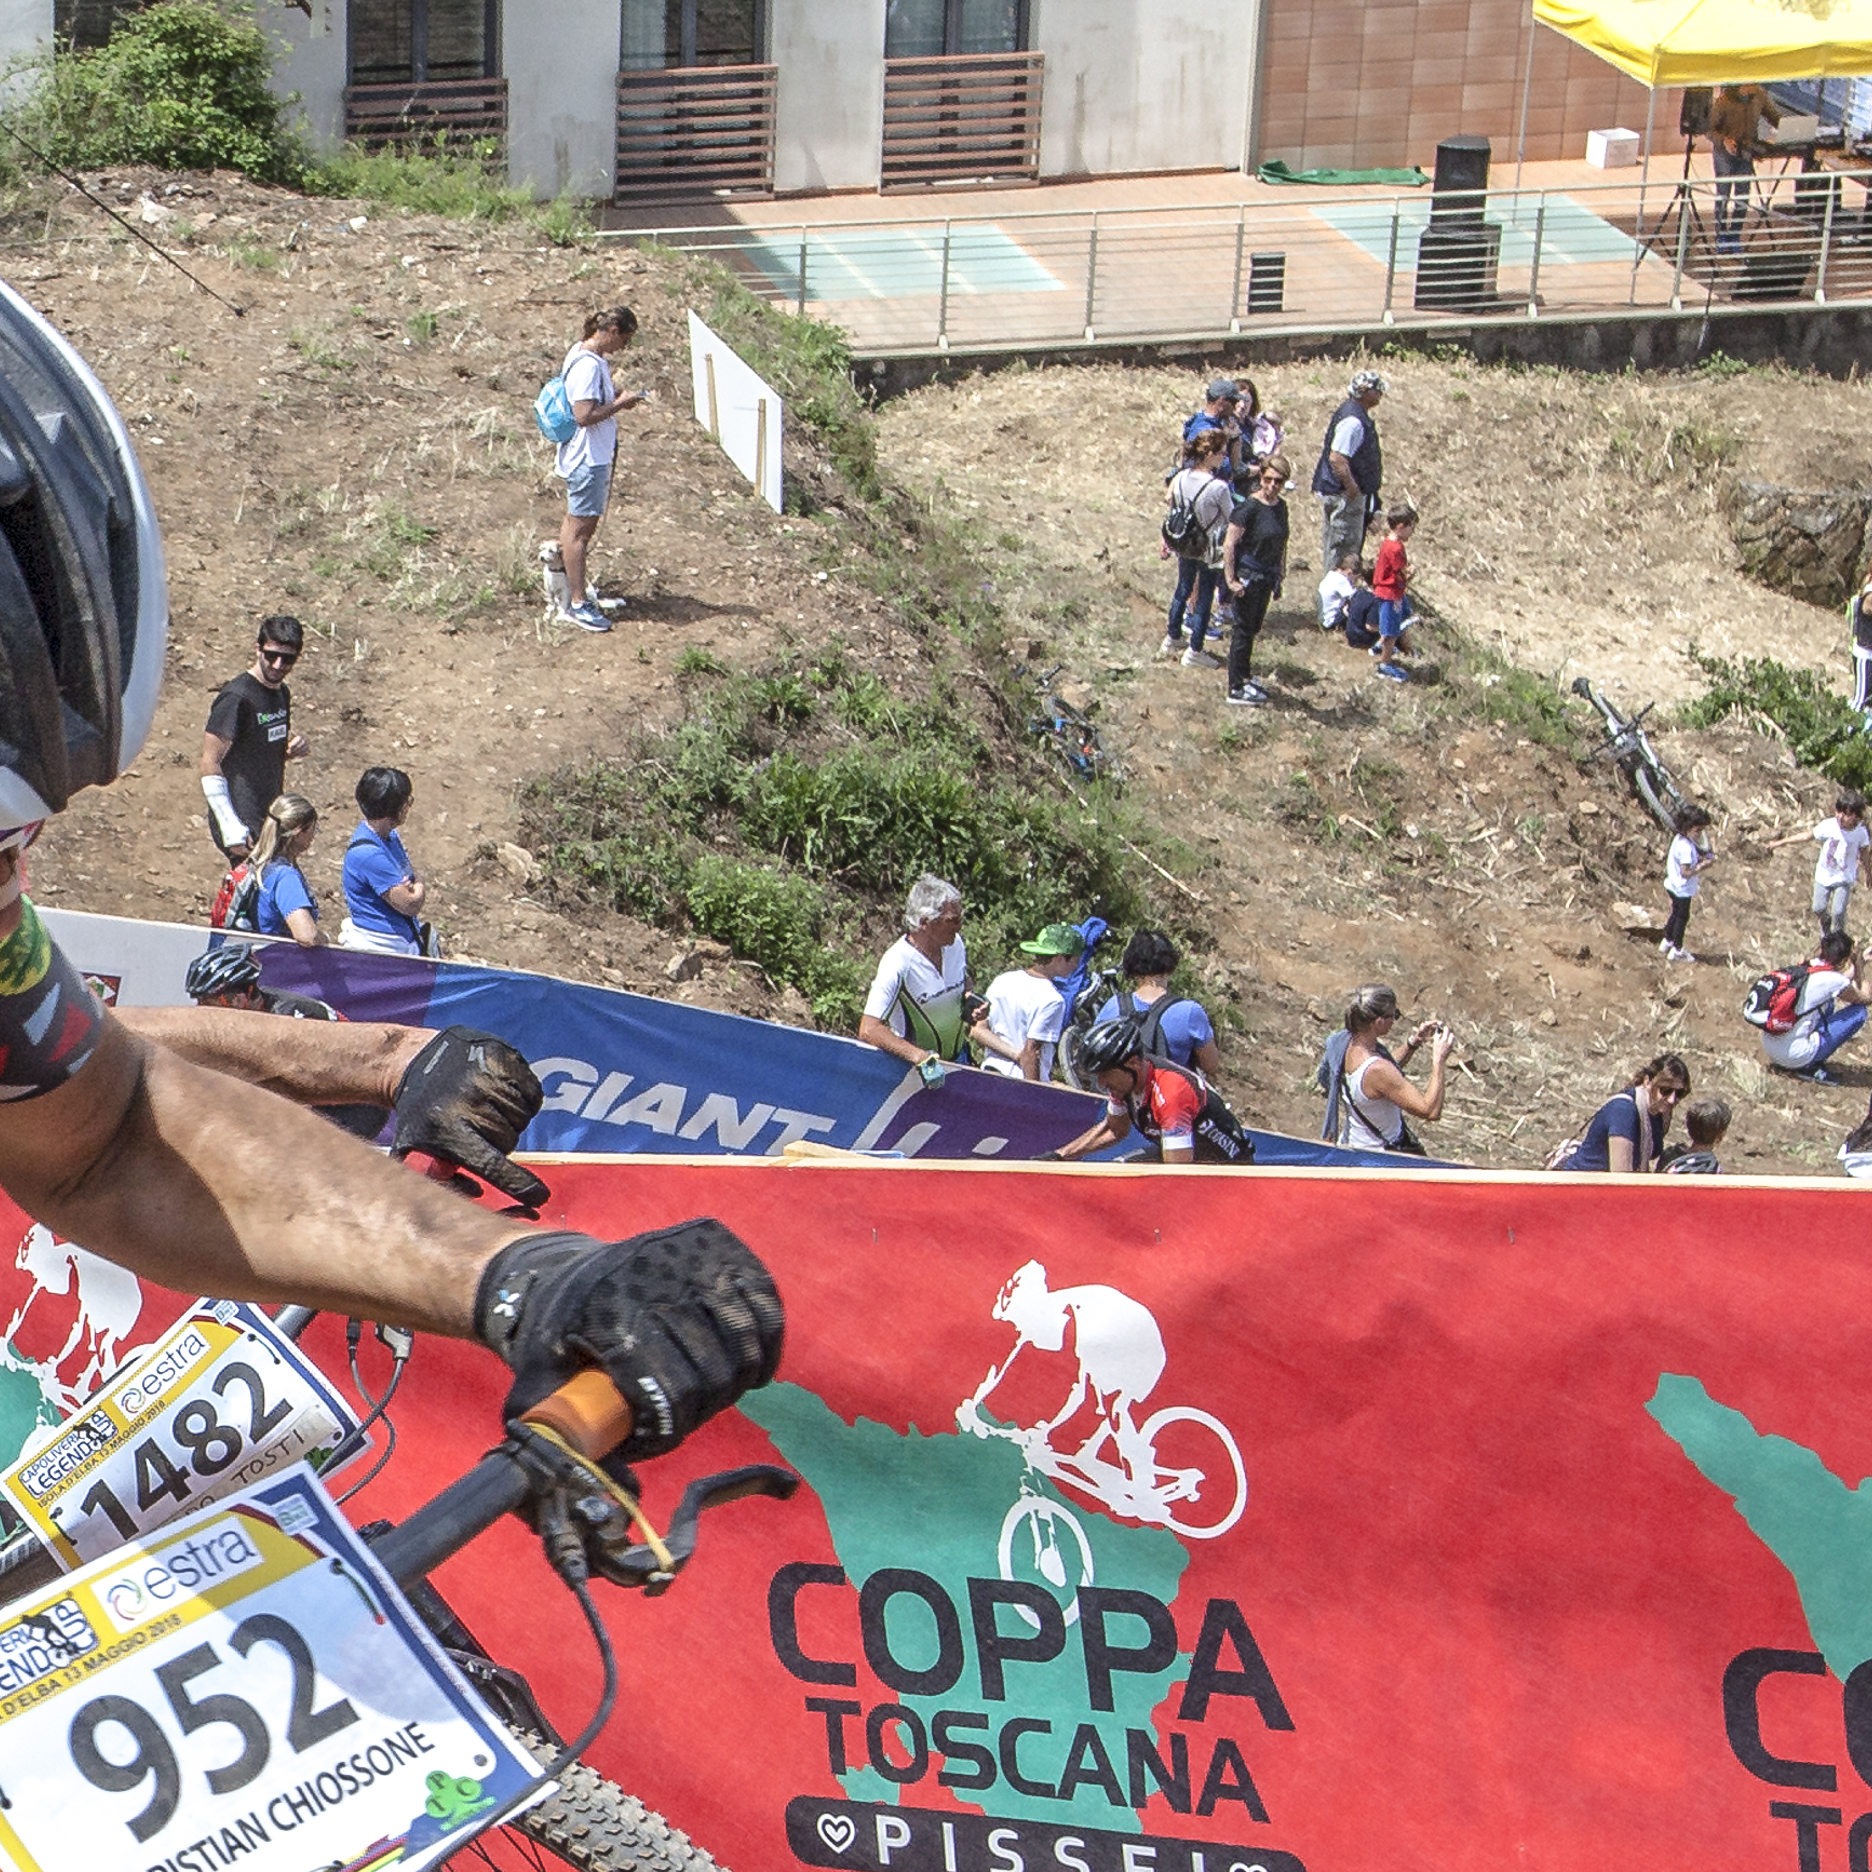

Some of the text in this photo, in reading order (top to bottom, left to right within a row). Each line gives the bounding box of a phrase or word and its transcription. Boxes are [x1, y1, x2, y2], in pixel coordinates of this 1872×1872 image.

[530, 1056, 837, 1152] GIANT
[139, 1332, 208, 1394] estra
[80, 1362, 294, 1542] 1482
[142, 1529, 256, 1601] estra
[82, 1634, 147, 1669] MAGGIO
[767, 1562, 1296, 1732] COPPA
[67, 1612, 361, 1845] 952
[266, 1720, 437, 1835] CHIOSSONE
[805, 1695, 1272, 1824] TOSCANA
